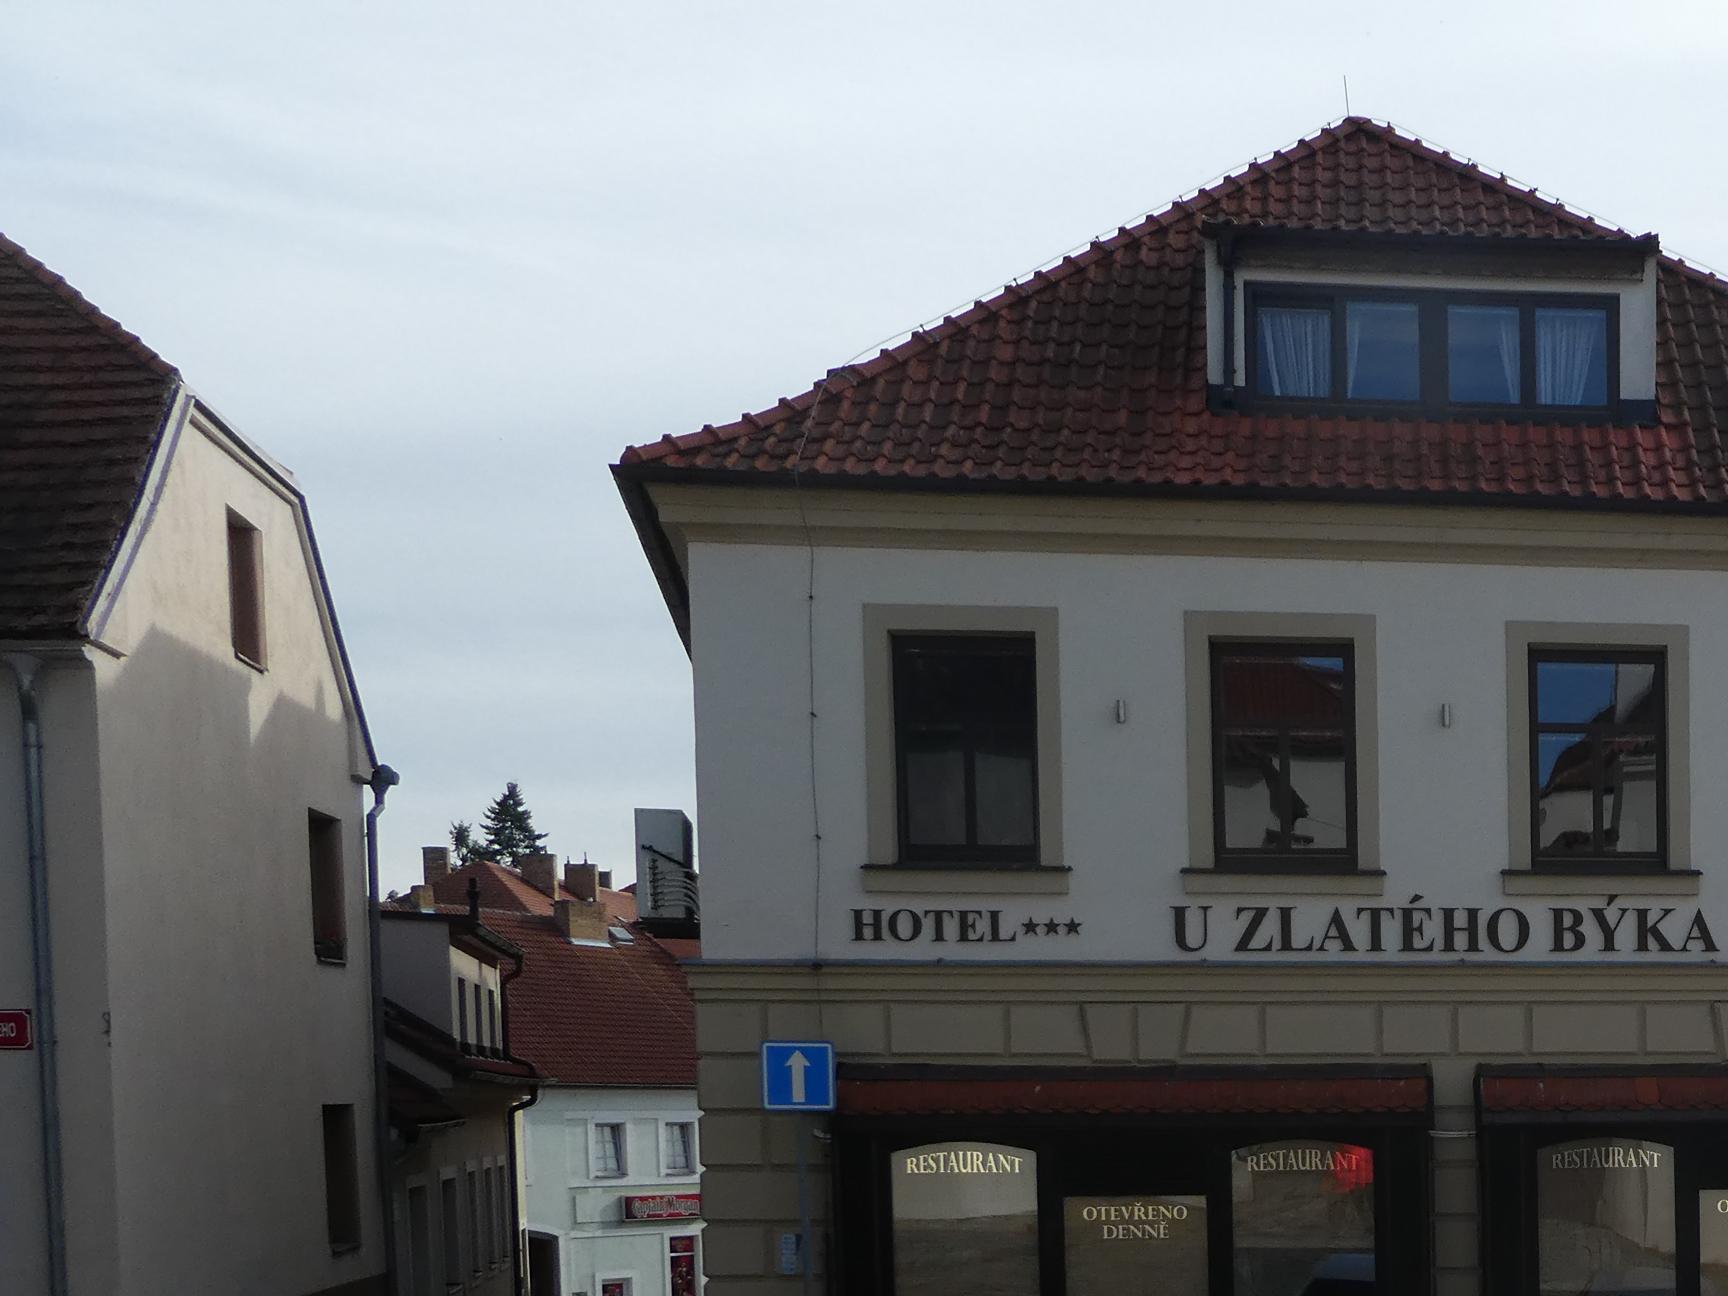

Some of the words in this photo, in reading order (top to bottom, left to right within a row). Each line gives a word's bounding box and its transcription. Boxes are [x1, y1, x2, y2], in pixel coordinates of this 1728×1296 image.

[1170, 906, 1210, 954] U
[1234, 894, 1533, 954] ZLATÉHO
[1549, 895, 1720, 954] BÝKA
[905, 1151, 1023, 1174] RESTAURANT
[1247, 1149, 1360, 1172] RESTAURANT
[1552, 1146, 1661, 1169] RESTAURANT
[1082, 1202, 1188, 1222] OTEVŘENO
[1102, 1221, 1170, 1240] DENNĚ
